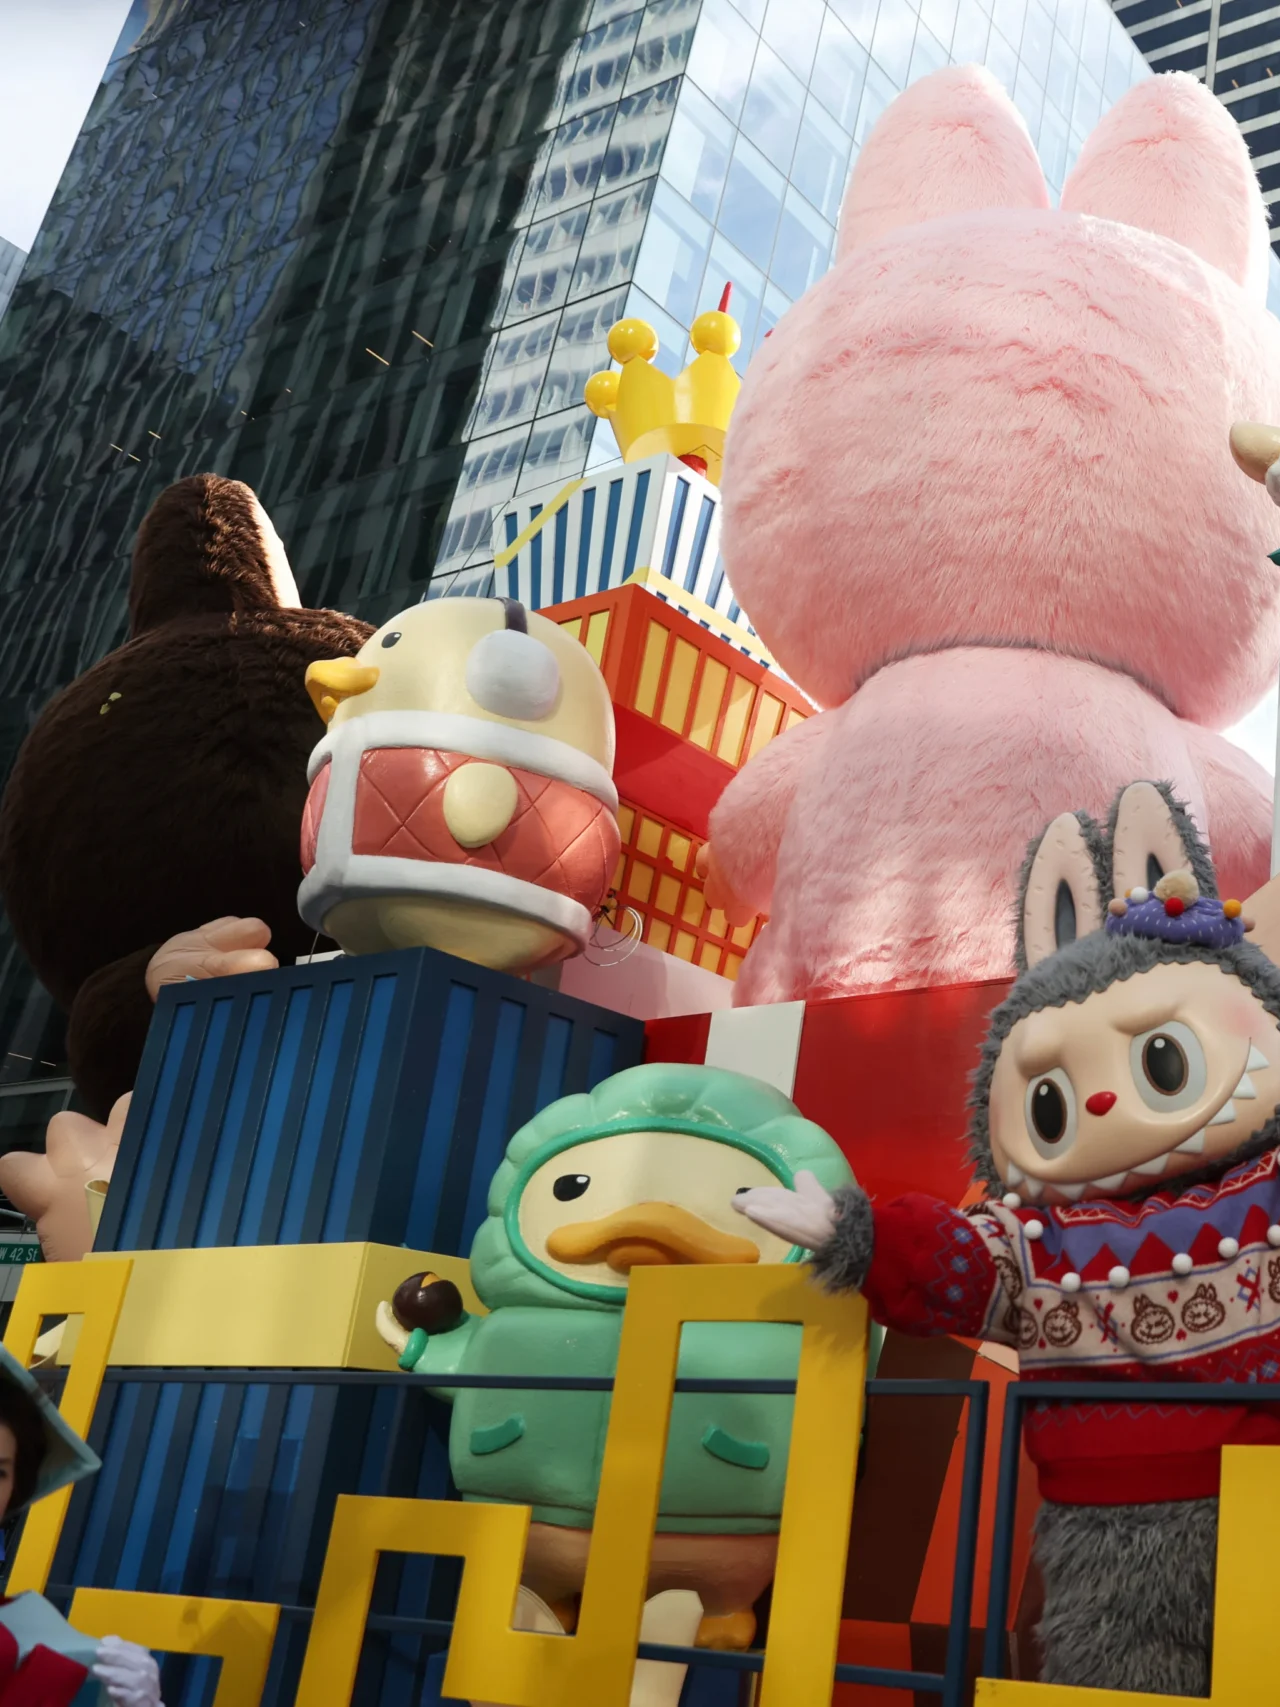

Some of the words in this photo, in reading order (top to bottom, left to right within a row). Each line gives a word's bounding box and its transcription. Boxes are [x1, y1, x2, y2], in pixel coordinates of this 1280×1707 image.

[0, 1247, 8, 1261] W
[9, 1247, 24, 1262] 42
[26, 1247, 38, 1262] St
